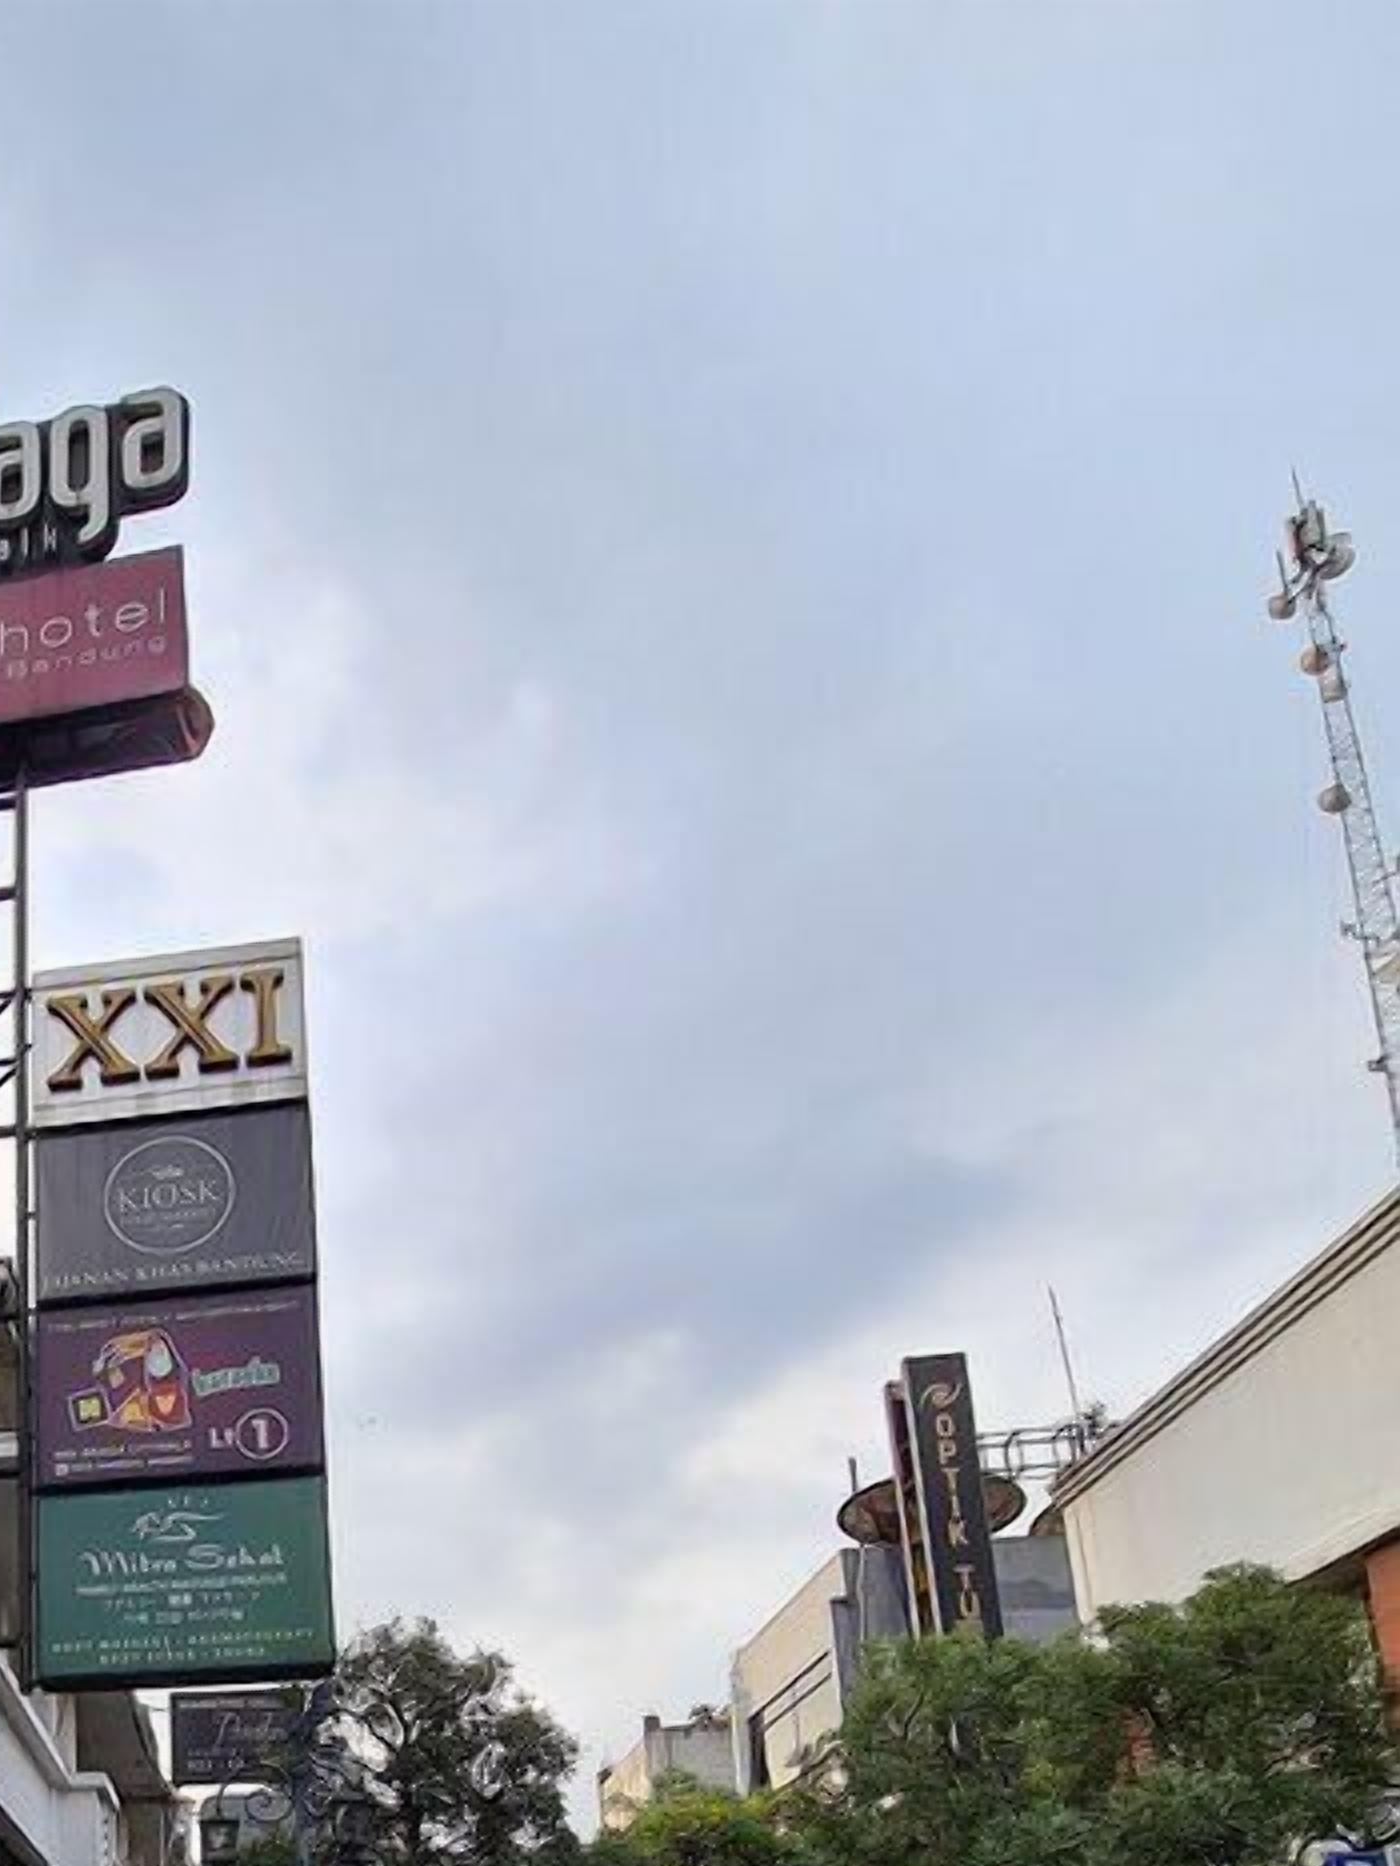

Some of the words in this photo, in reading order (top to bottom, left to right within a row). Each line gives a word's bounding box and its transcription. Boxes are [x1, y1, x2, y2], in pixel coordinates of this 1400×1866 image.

[6, 636, 168, 680] Bandung
[46, 966, 293, 1092] XXI
[118, 1178, 222, 1216] KIOSK
